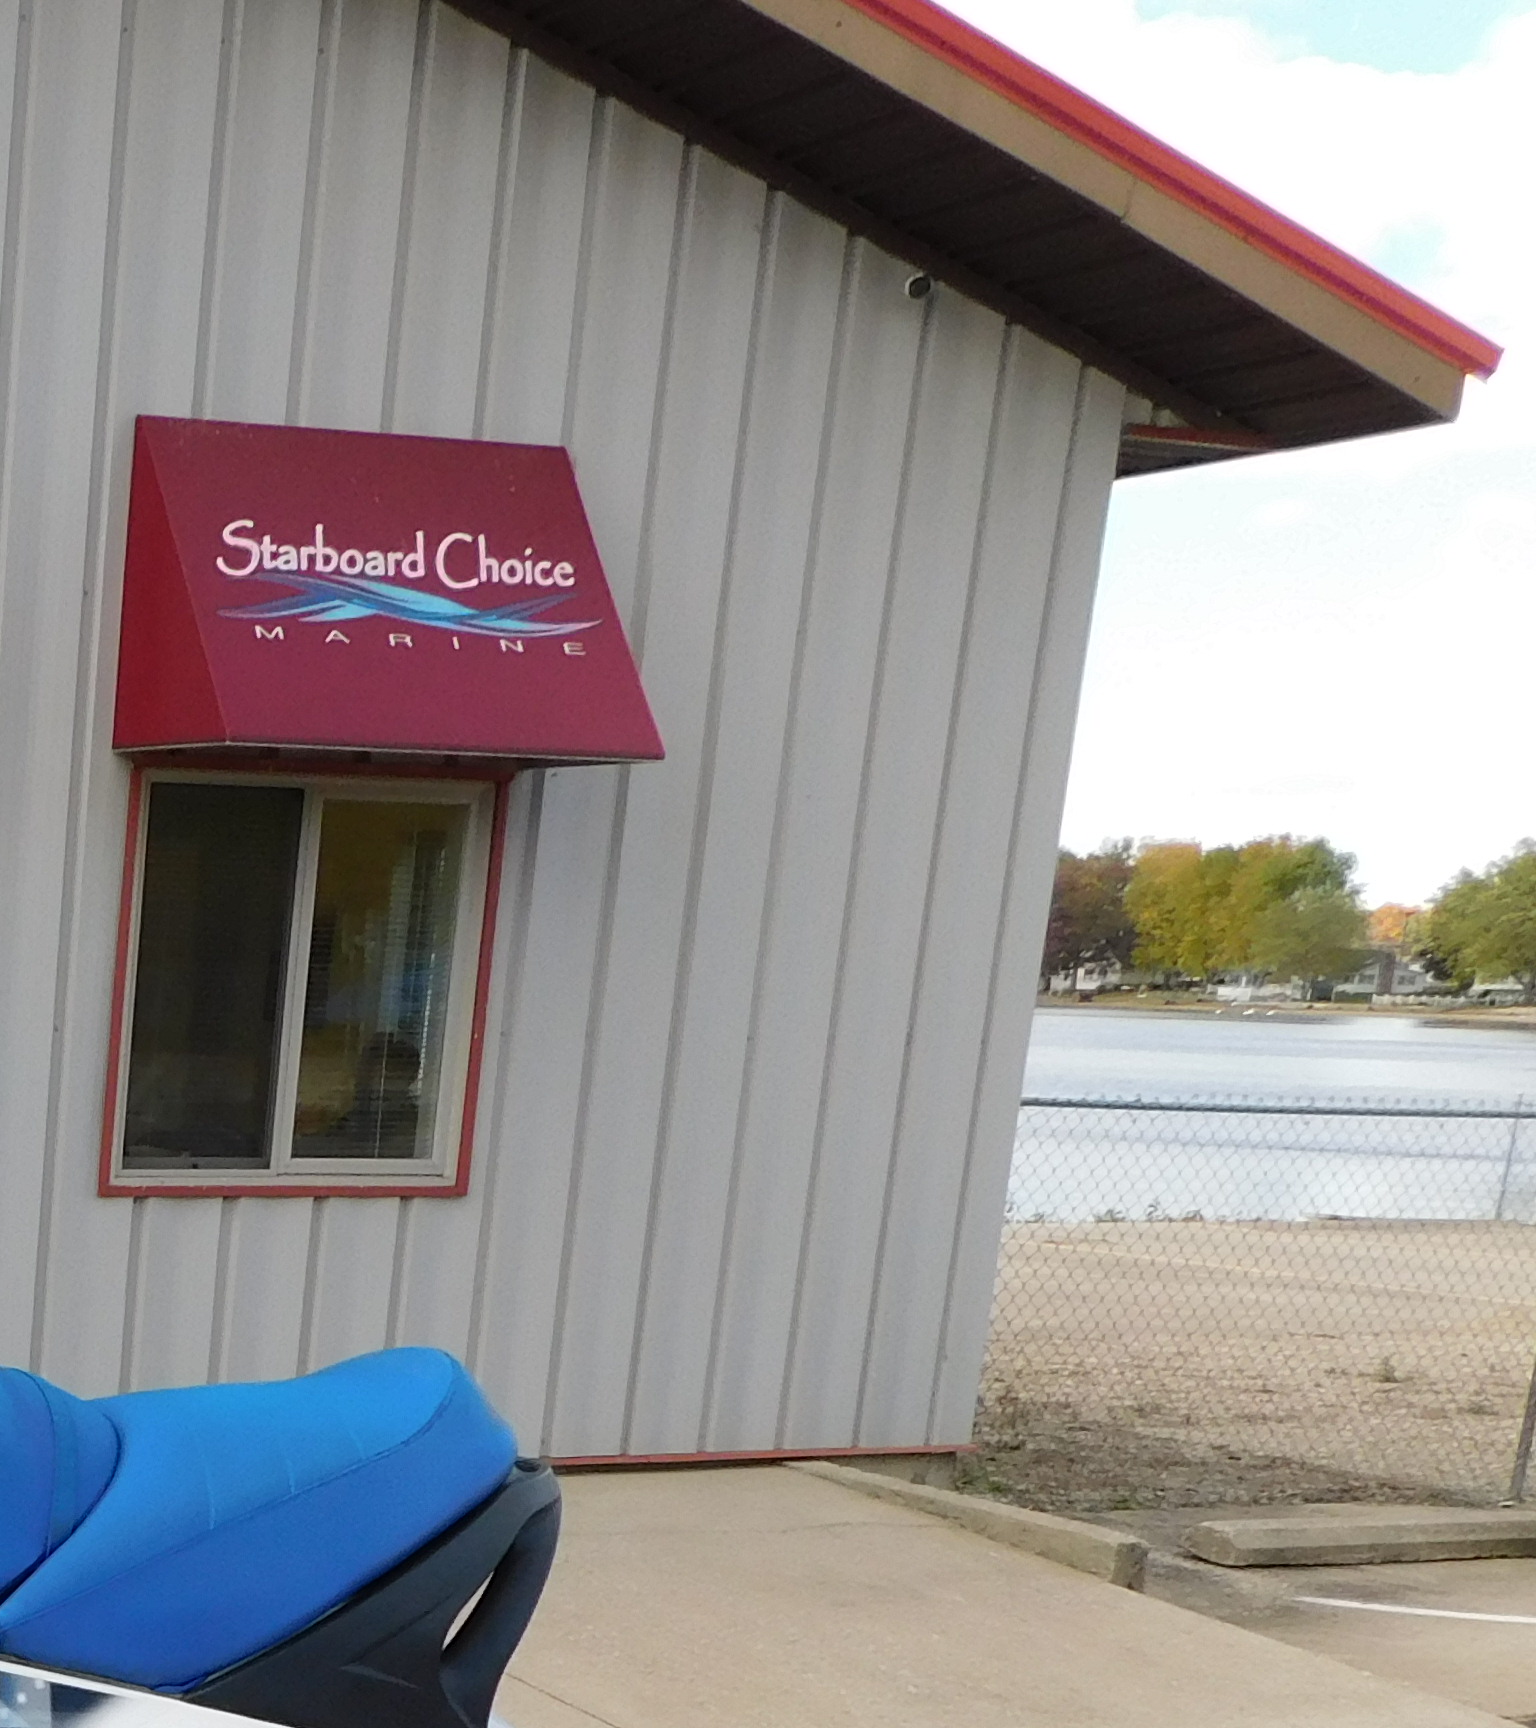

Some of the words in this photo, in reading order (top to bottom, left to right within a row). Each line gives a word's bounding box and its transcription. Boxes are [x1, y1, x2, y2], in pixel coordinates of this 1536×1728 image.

[216, 519, 426, 579] Starboard
[435, 532, 575, 590] Choice
[254, 625, 587, 657] MARINE
